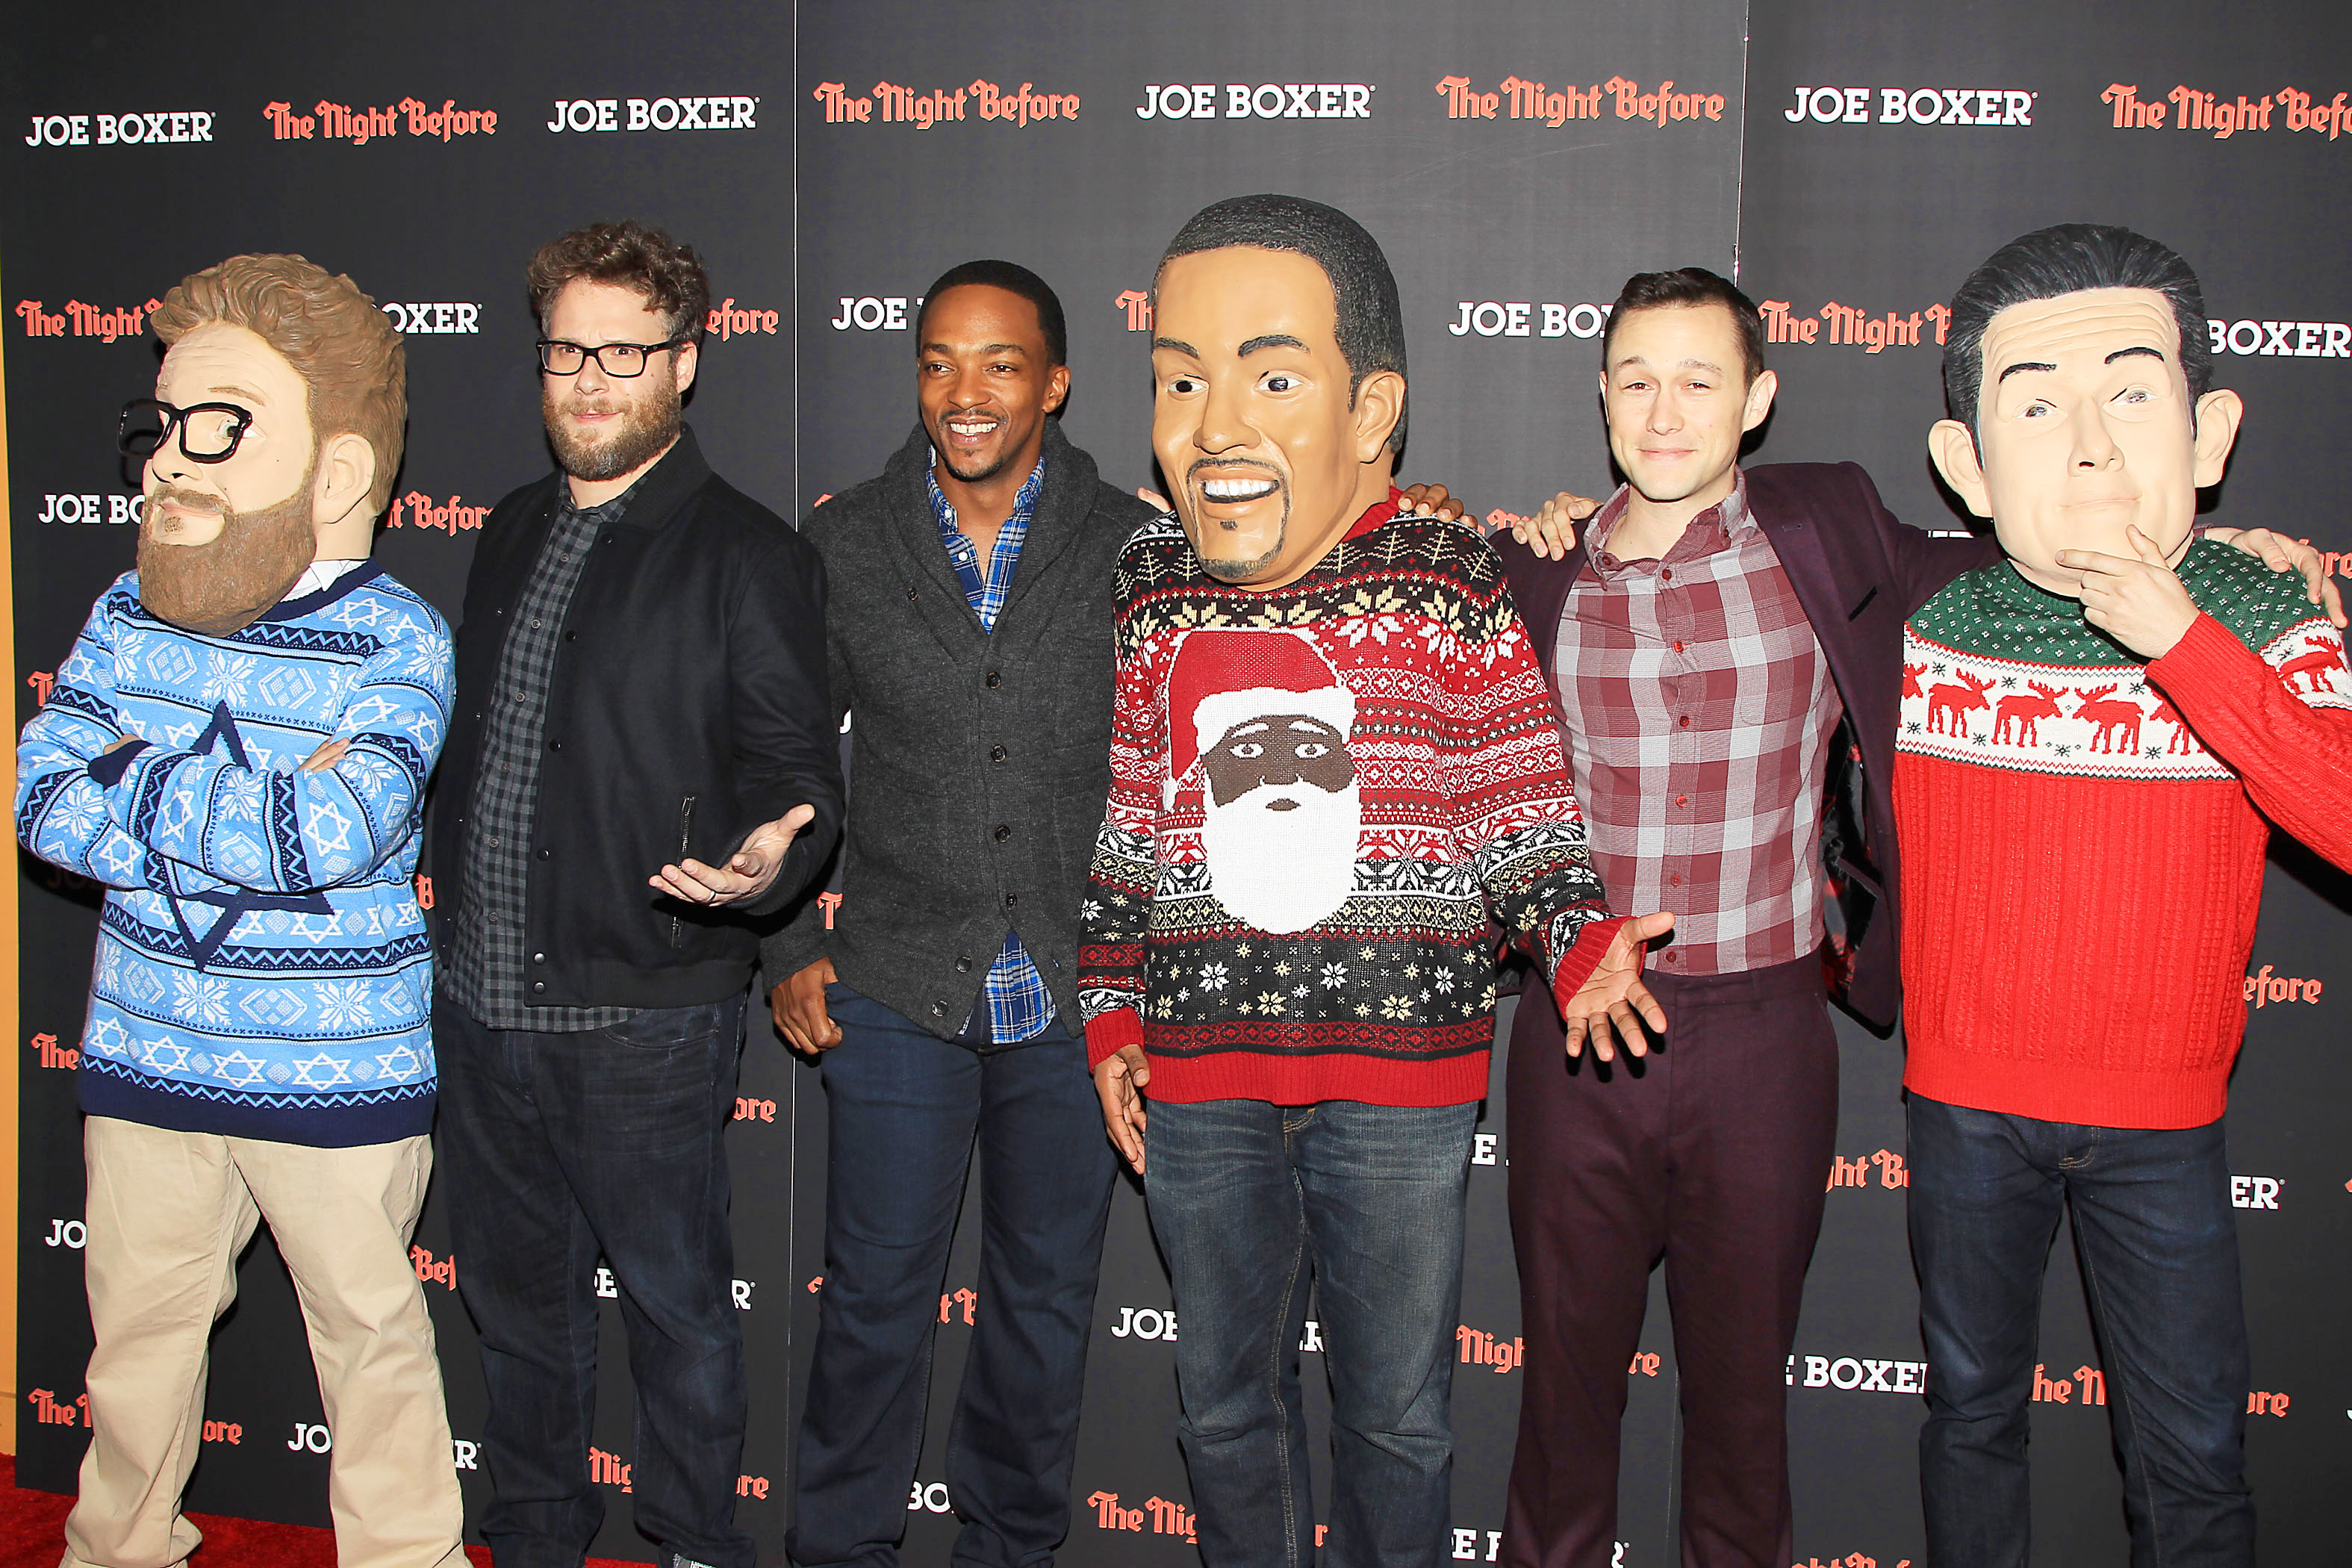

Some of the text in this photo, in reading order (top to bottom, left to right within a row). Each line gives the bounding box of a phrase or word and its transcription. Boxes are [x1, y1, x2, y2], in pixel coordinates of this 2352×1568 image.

[262, 96, 497, 145] The Night Before
[547, 96, 756, 133] JOE BOXER
[812, 78, 1080, 129] The Night Before
[1136, 84, 1371, 119] JOE BOXER
[1434, 74, 1726, 128] The Night Before
[1784, 87, 2032, 125] JOE BOXER
[2100, 82, 2352, 140] The Night Bef
[25, 111, 213, 146] JOE BOXER
[14, 299, 144, 343] The Night
[382, 302, 479, 334] OXER
[704, 297, 779, 341] efore
[831, 297, 907, 330] JOE
[1114, 289, 1153, 331] Th
[1449, 302, 1531, 337] JOE
[1757, 299, 1820, 343] The
[1819, 300, 1923, 353] Night
[38, 494, 101, 523] JOE
[404, 490, 494, 536] Befor
[2241, 961, 2324, 1012] efore
[30, 1032, 79, 1071] The
[45, 1219, 87, 1249] JO
[1803, 1355, 1928, 1394] BOXE
[2032, 1363, 2072, 1404] he
[28, 1388, 76, 1427] The
[287, 1422, 330, 1454] JO
[1086, 1490, 1145, 1533] The
